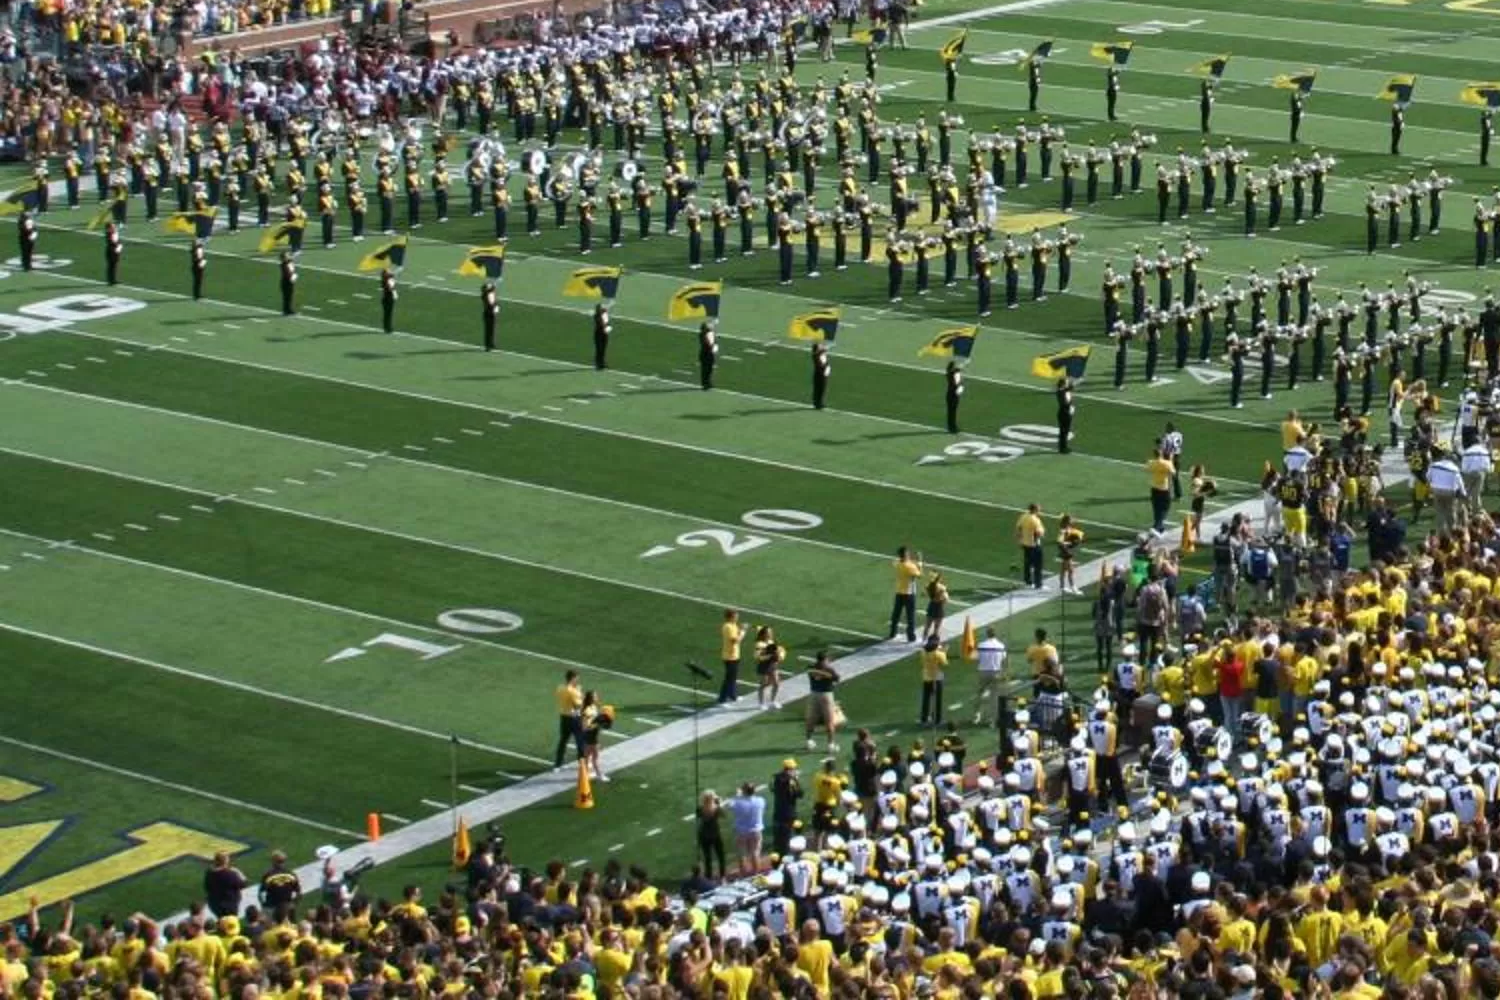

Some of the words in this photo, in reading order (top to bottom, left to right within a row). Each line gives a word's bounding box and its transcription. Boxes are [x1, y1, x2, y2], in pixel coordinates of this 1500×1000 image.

[944, 423, 1075, 463] 30
[677, 509, 823, 554] 20
[363, 608, 523, 660] 10
